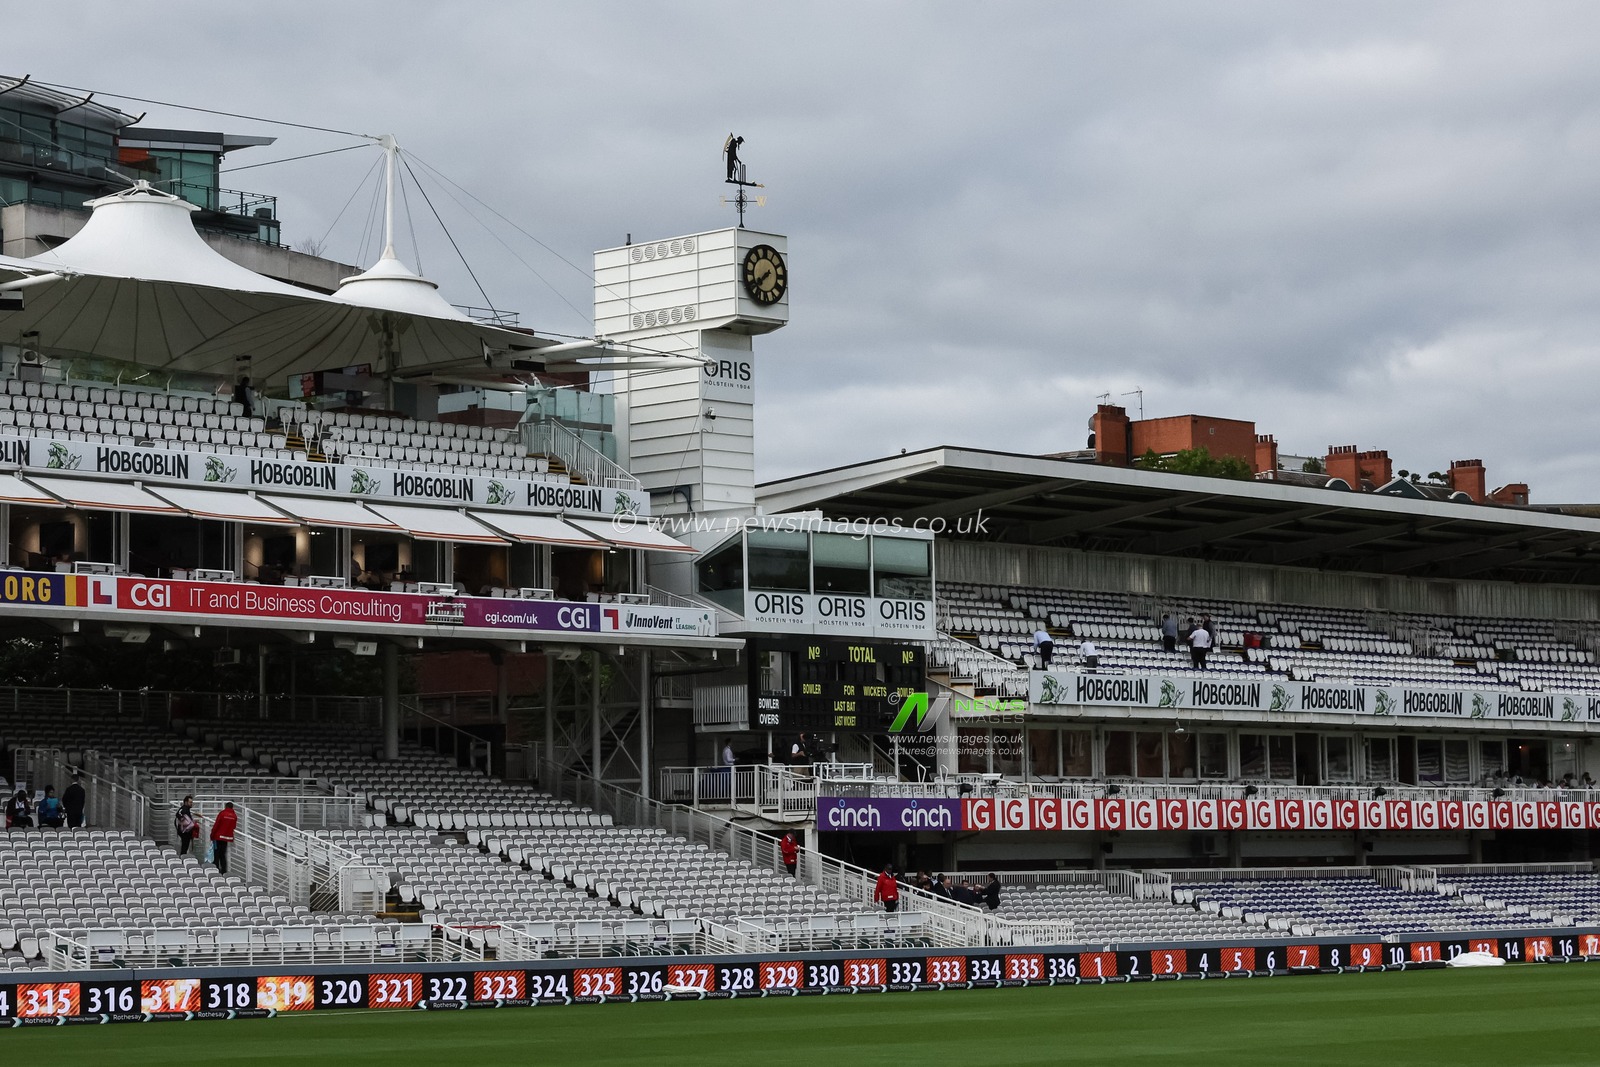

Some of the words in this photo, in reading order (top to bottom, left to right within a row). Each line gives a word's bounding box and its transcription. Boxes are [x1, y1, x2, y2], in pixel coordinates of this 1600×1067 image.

[755, 195, 767, 207] W
[703, 360, 751, 381] ORIS
[97, 446, 189, 480] HOBGOBLIN
[251, 459, 336, 491] HOBGOBLIN
[393, 472, 474, 502] HOBGOBLIN
[527, 483, 602, 512] HOBGOBLIN
[130, 583, 171, 608] CGI
[189, 587, 205, 607] IT
[209, 590, 240, 609] and
[245, 591, 316, 613] Business
[319, 595, 402, 622] Consulting
[754, 593, 804, 615] ORIS
[818, 596, 866, 618] ORIS
[879, 600, 926, 621] ORIS
[485, 611, 538, 626] cgi.com/uk
[557, 606, 590, 629] CGI
[633, 613, 673, 629] InnoVent
[848, 646, 876, 663] TOTAL
[802, 683, 821, 695] BOWLER
[844, 685, 855, 696] FOR
[863, 686, 887, 697] WICKETS
[1076, 676, 1148, 704] HOBGOBLIN
[1192, 681, 1260, 708] HOBGOBLIN
[1301, 685, 1365, 712] HOBGOBLIN
[758, 698, 779, 710] BOWLER
[1403, 690, 1463, 716] HOBGOBLIN
[1498, 694, 1554, 719] HOBGOBLIN
[759, 714, 779, 725] OVERS
[828, 799, 881, 827] cinch
[901, 799, 951, 827] cinch
[967, 800, 990, 829] IG
[1001, 800, 1024, 829] IG
[1034, 800, 1057, 829] IG
[1067, 800, 1089, 829] IG
[1100, 800, 1121, 829] IG
[1131, 800, 1151, 829] IG
[1162, 800, 1183, 829] IG
[1193, 800, 1213, 829] IG
[1222, 801, 1243, 829] IG
[1251, 801, 1271, 828] IG
[1279, 801, 1300, 828] IG
[1308, 801, 1327, 828] IG
[1335, 801, 1355, 828] IG
[1363, 801, 1382, 828] IG
[1389, 801, 1408, 828] IG
[1416, 802, 1434, 828] IG
[1442, 802, 1460, 828] IG
[1467, 802, 1484, 828] IG
[1492, 802, 1509, 828] IG
[1517, 802, 1534, 828] IG
[1540, 802, 1558, 828] IG
[1564, 802, 1581, 828] IG
[1299, 949, 1307, 966] 7
[1330, 948, 1339, 967] 8
[1362, 947, 1371, 966] 9
[1389, 946, 1404, 964] 10
[1418, 945, 1432, 962] 11
[1504, 941, 1519, 959] 14
[1532, 940, 1546, 957] 15
[1559, 939, 1573, 956] 16
[1586, 938, 1599, 955] 17
[932, 960, 961, 982] 333
[971, 959, 1001, 980] 334
[1010, 958, 1038, 979] 335
[1049, 957, 1076, 978] 336
[1094, 957, 1102, 976] 1
[1130, 955, 1139, 975] 2
[1164, 954, 1173, 973] 3
[1199, 952, 1208, 971] 4
[1233, 952, 1242, 971] 5
[1267, 950, 1275, 970] 6
[581, 972, 615, 996] 325
[628, 970, 663, 994] 326
[721, 968, 754, 990] 328
[765, 966, 798, 988] 329
[808, 964, 839, 986] 330
[850, 963, 879, 985] 331
[891, 962, 922, 983] 332
[150, 985, 192, 1011] 317
[208, 982, 250, 1008] 318
[265, 981, 307, 1006] 319
[321, 979, 362, 1004] 320
[376, 978, 413, 1003] 321
[429, 977, 467, 1001] 322
[481, 975, 518, 999] 323
[532, 974, 568, 998] 324
[25, 989, 71, 1015] 315
[88, 986, 134, 1012] 316
[112, 1013, 142, 1021] Rothesay
